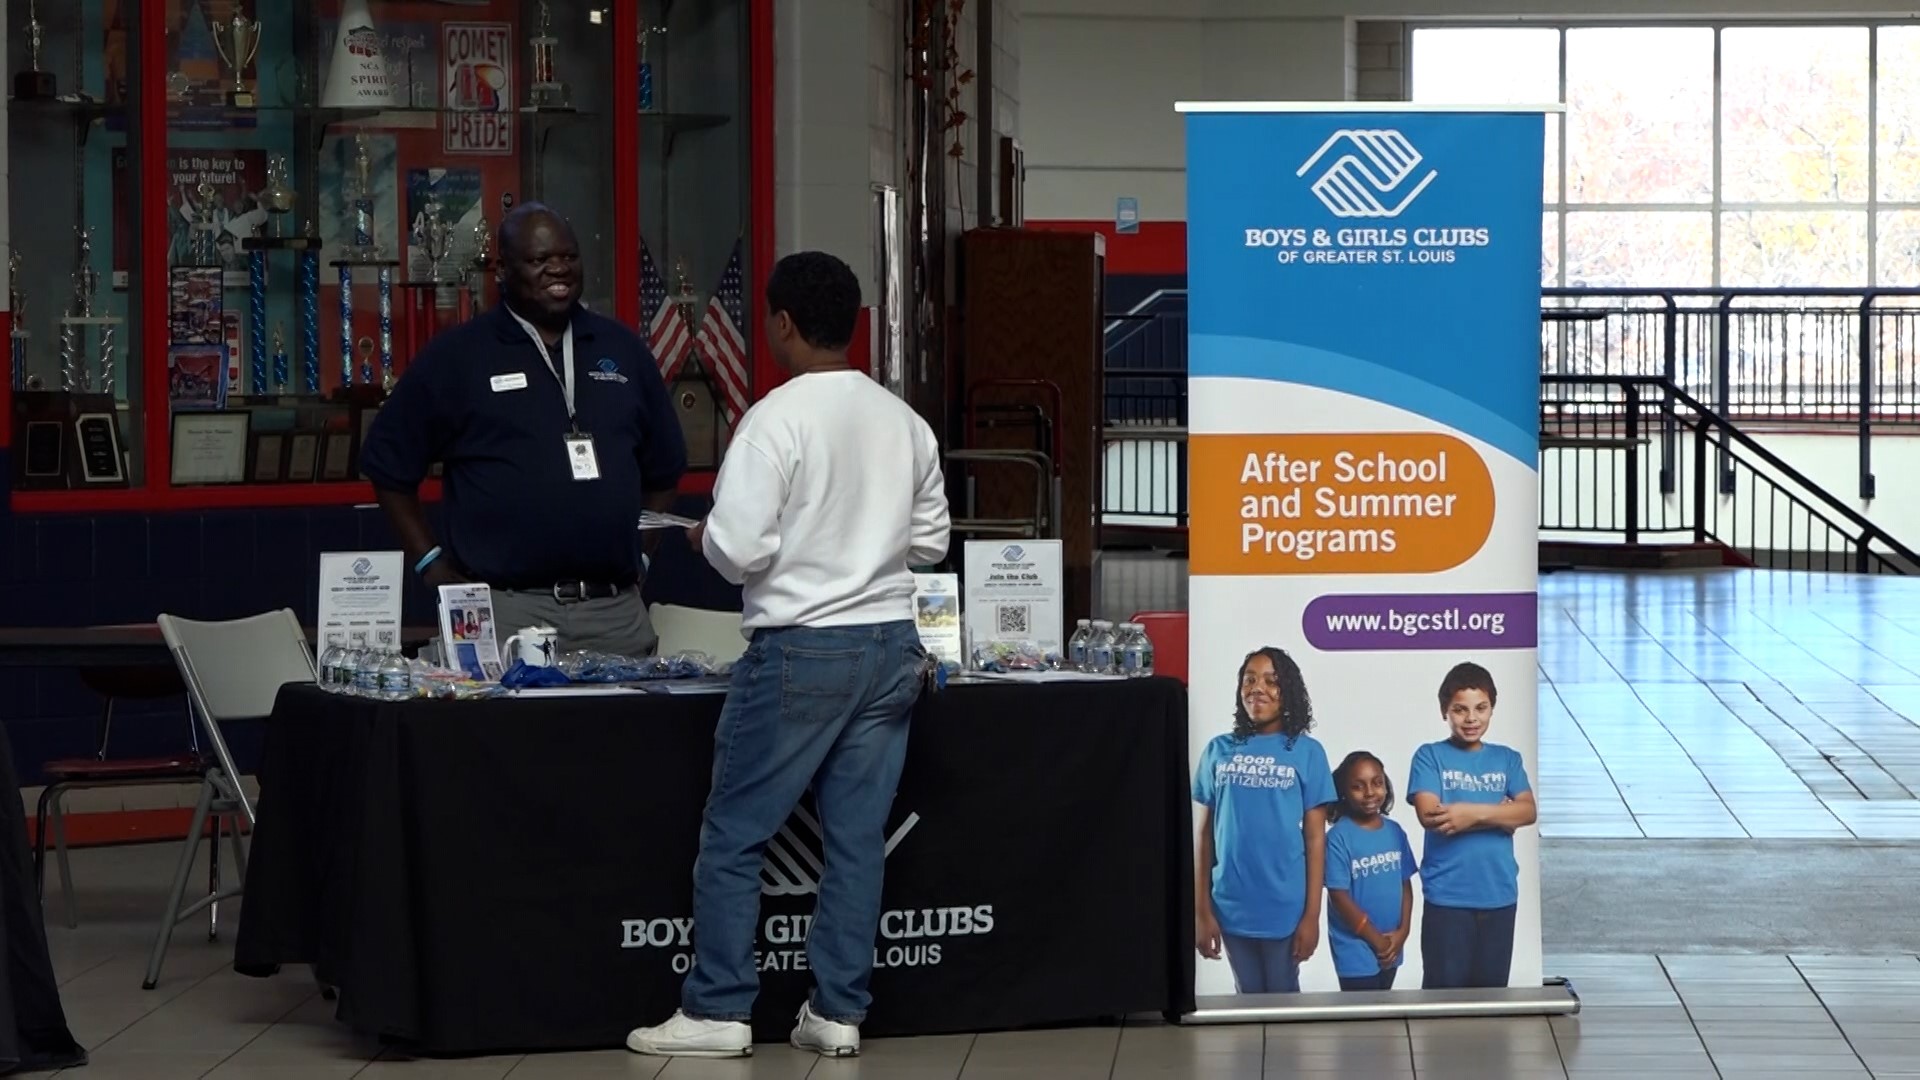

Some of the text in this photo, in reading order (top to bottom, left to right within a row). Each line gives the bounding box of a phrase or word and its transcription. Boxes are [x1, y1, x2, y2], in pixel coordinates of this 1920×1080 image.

[447, 30, 506, 66] COMET
[449, 111, 507, 147] PRIDE
[179, 157, 189, 170] is
[192, 157, 208, 170] the
[212, 157, 231, 172] key
[234, 158, 245, 170] to
[173, 173, 197, 185] your
[1245, 228, 1489, 246] BOYS & GIRLS CLUBS
[1278, 250, 1456, 264] OF GREATER ST. LOUIS
[1241, 451, 1446, 484] After School
[1240, 486, 1456, 518] and Summer
[1242, 523, 1396, 560] Programs
[1326, 608, 1505, 636] www.bgcstl.org
[1233, 754, 1276, 765] GOOD
[621, 905, 993, 948] BOY CLUBS
[754, 950, 813, 972] EATE
[872, 944, 942, 969] LOUIS
